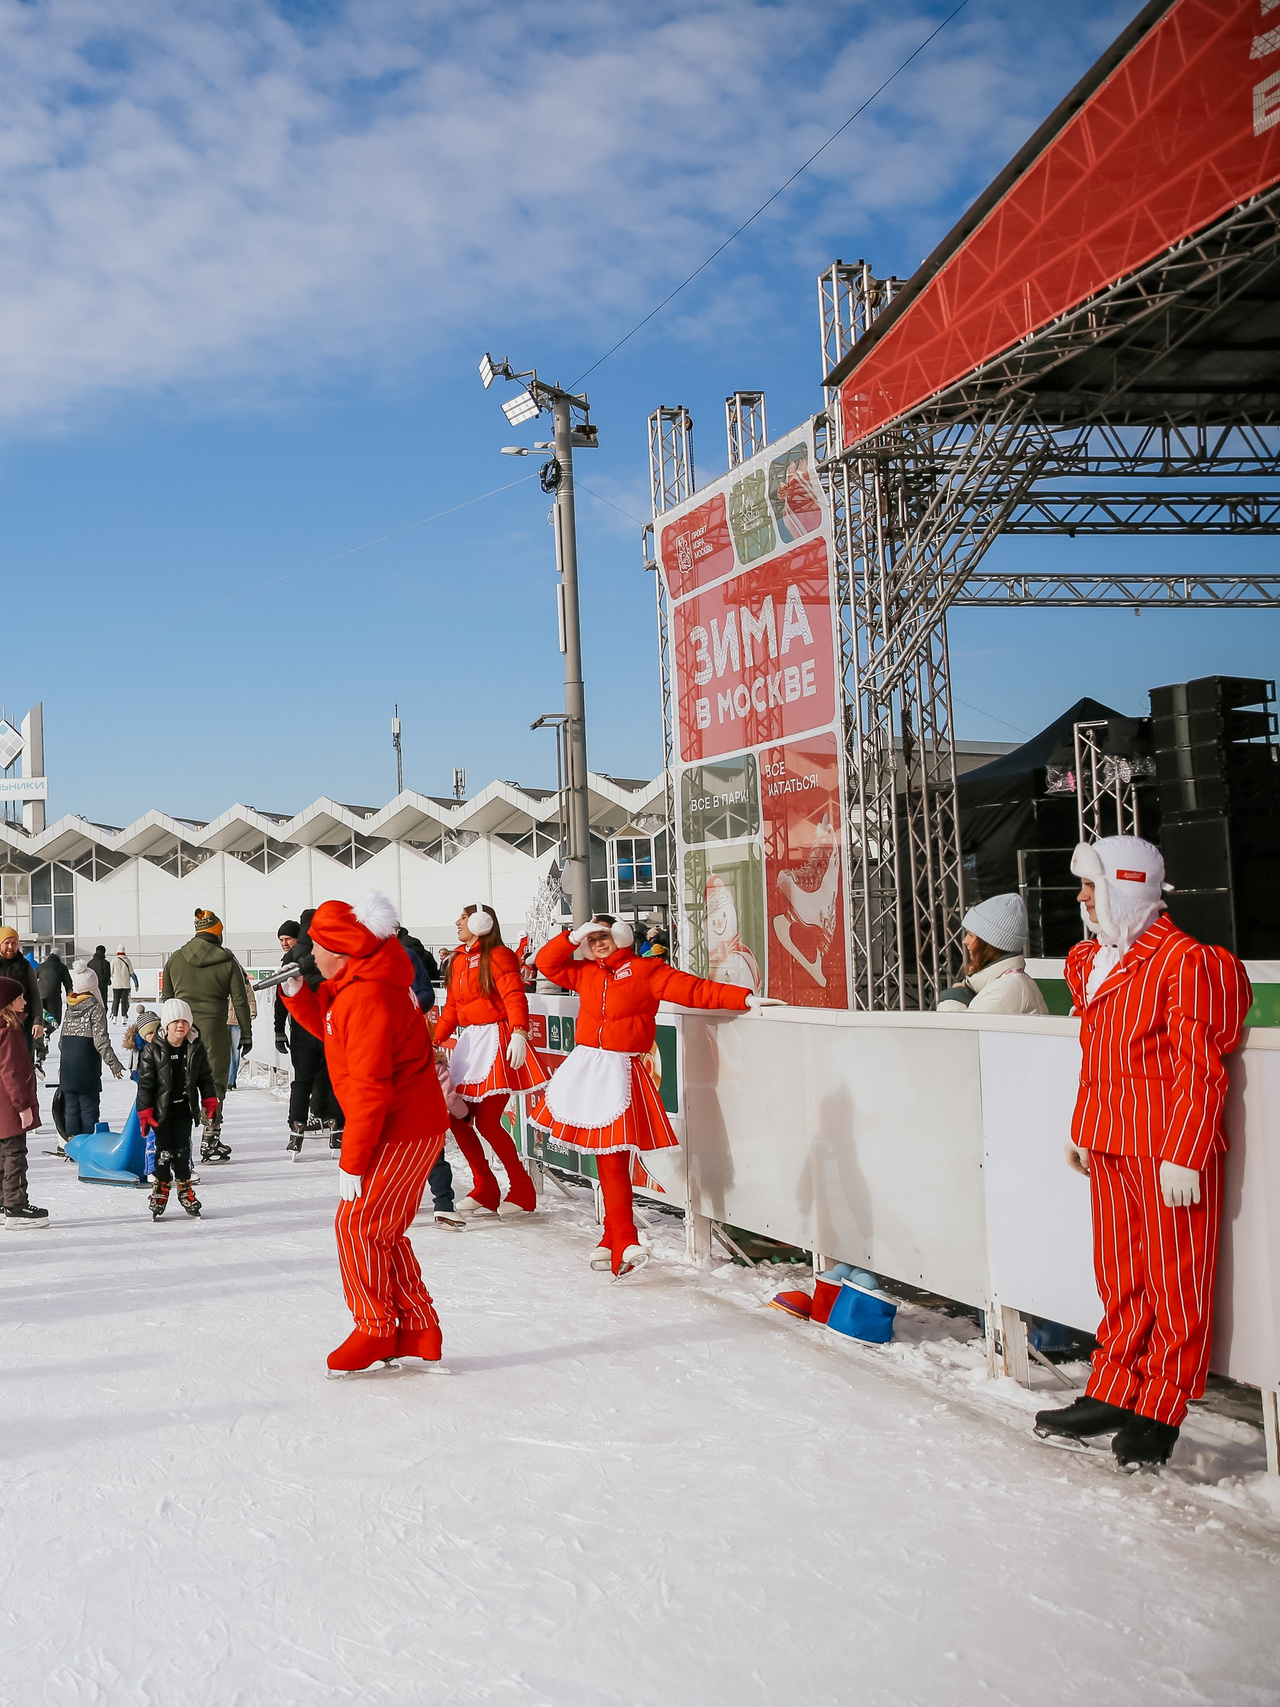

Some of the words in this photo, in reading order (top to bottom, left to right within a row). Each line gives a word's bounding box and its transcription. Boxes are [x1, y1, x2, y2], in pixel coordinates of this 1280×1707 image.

[689, 583, 815, 686] ЗИМА
[695, 697, 711, 730] В
[717, 658, 817, 725] МОСКВЕ
[764, 761, 786, 778] ВСЕ
[768, 773, 819, 797] КАТАТЬСЯ!
[691, 797, 711, 812] ВСЕ
[713, 795, 720, 808] В
[721, 788, 749, 806] ПАРК!
